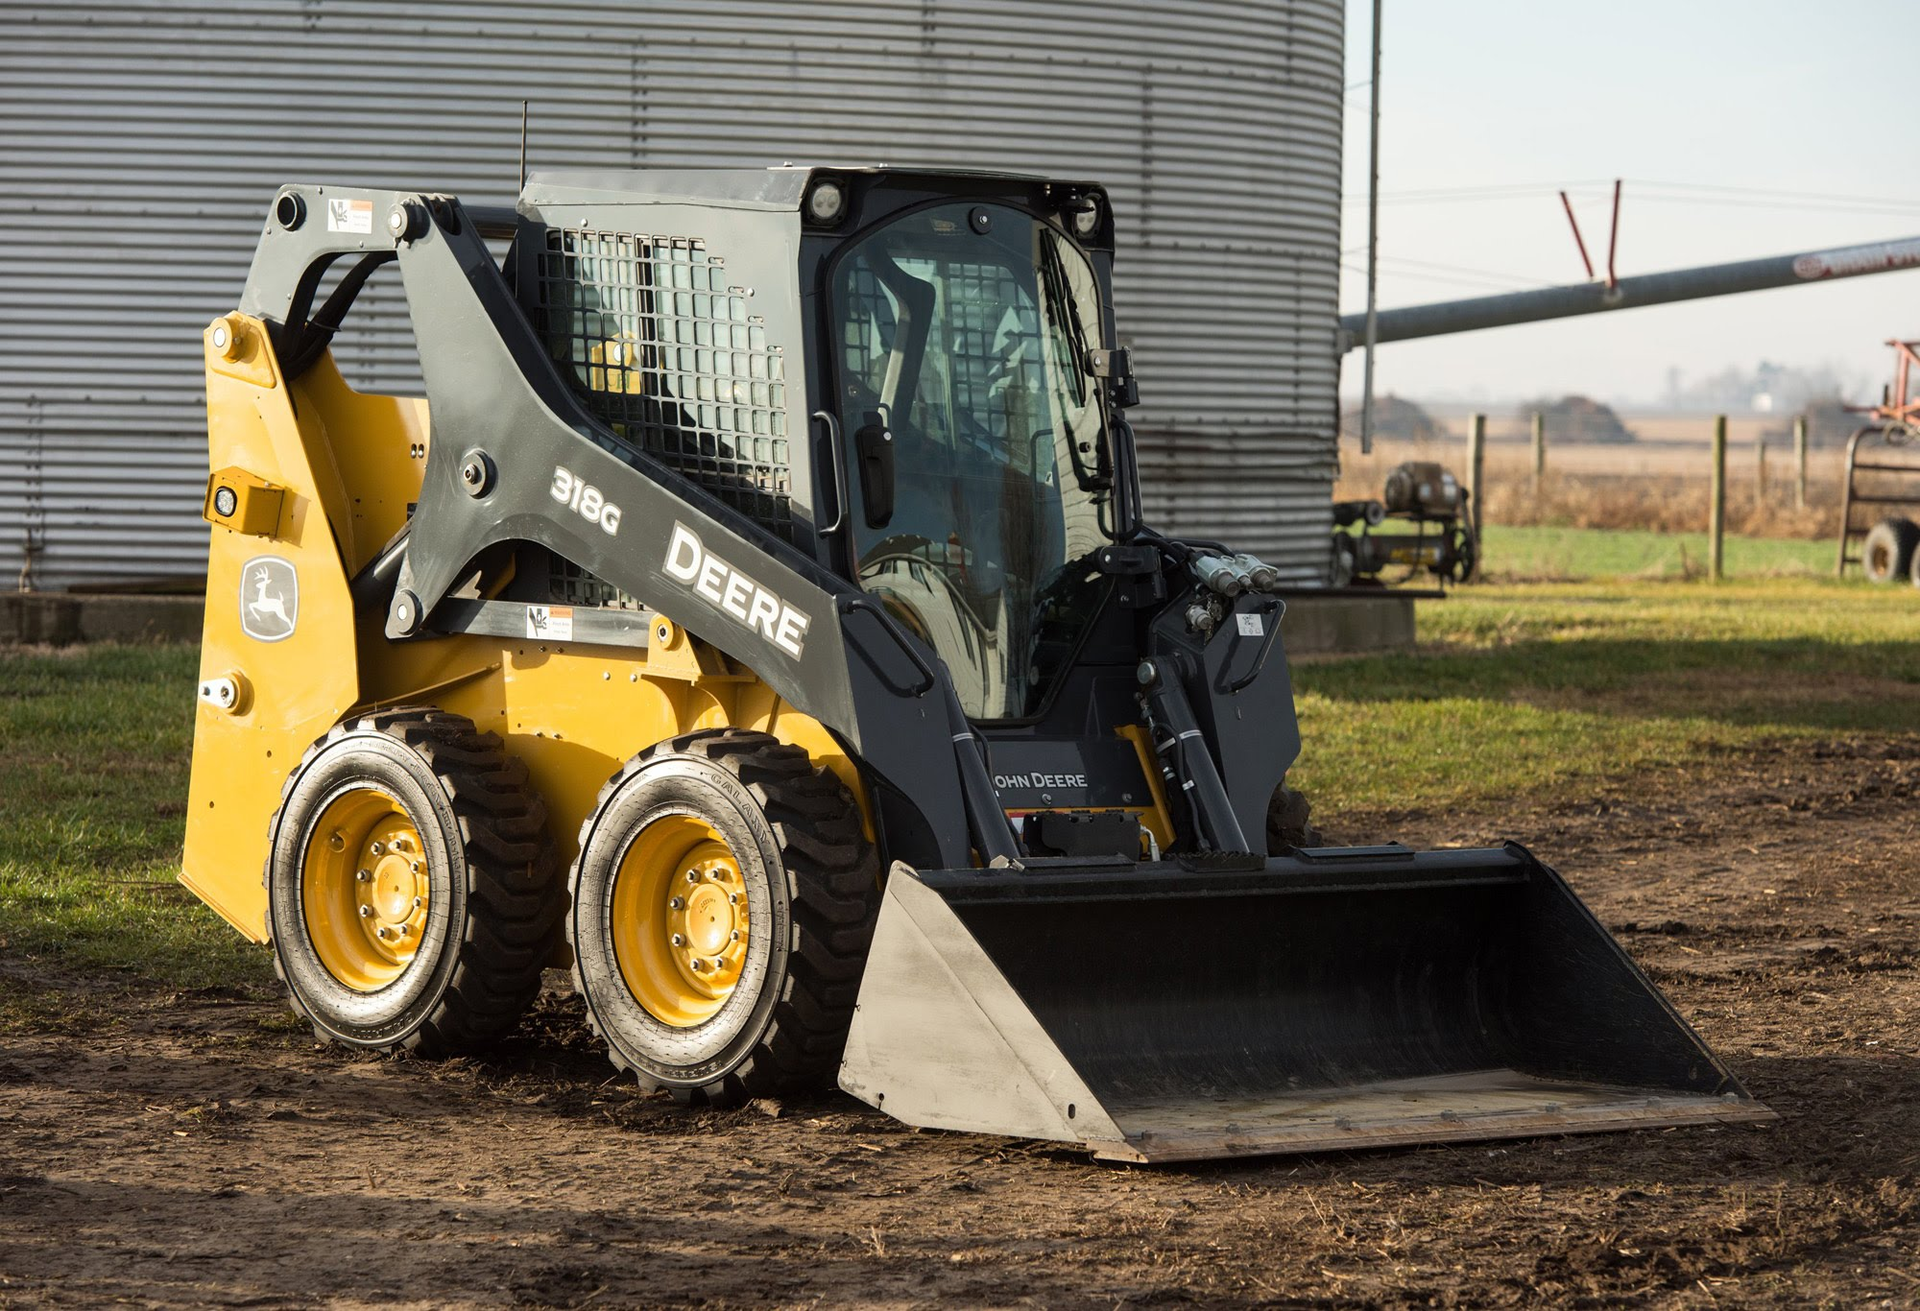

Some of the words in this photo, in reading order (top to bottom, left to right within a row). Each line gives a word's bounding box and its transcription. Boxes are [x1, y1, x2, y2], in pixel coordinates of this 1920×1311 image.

[550, 466, 622, 536] 318G
[663, 521, 810, 659] DEERE
[710, 773, 771, 845] GALAXY
[994, 774, 1031, 789] OHN
[1031, 772, 1088, 788] DEERE
